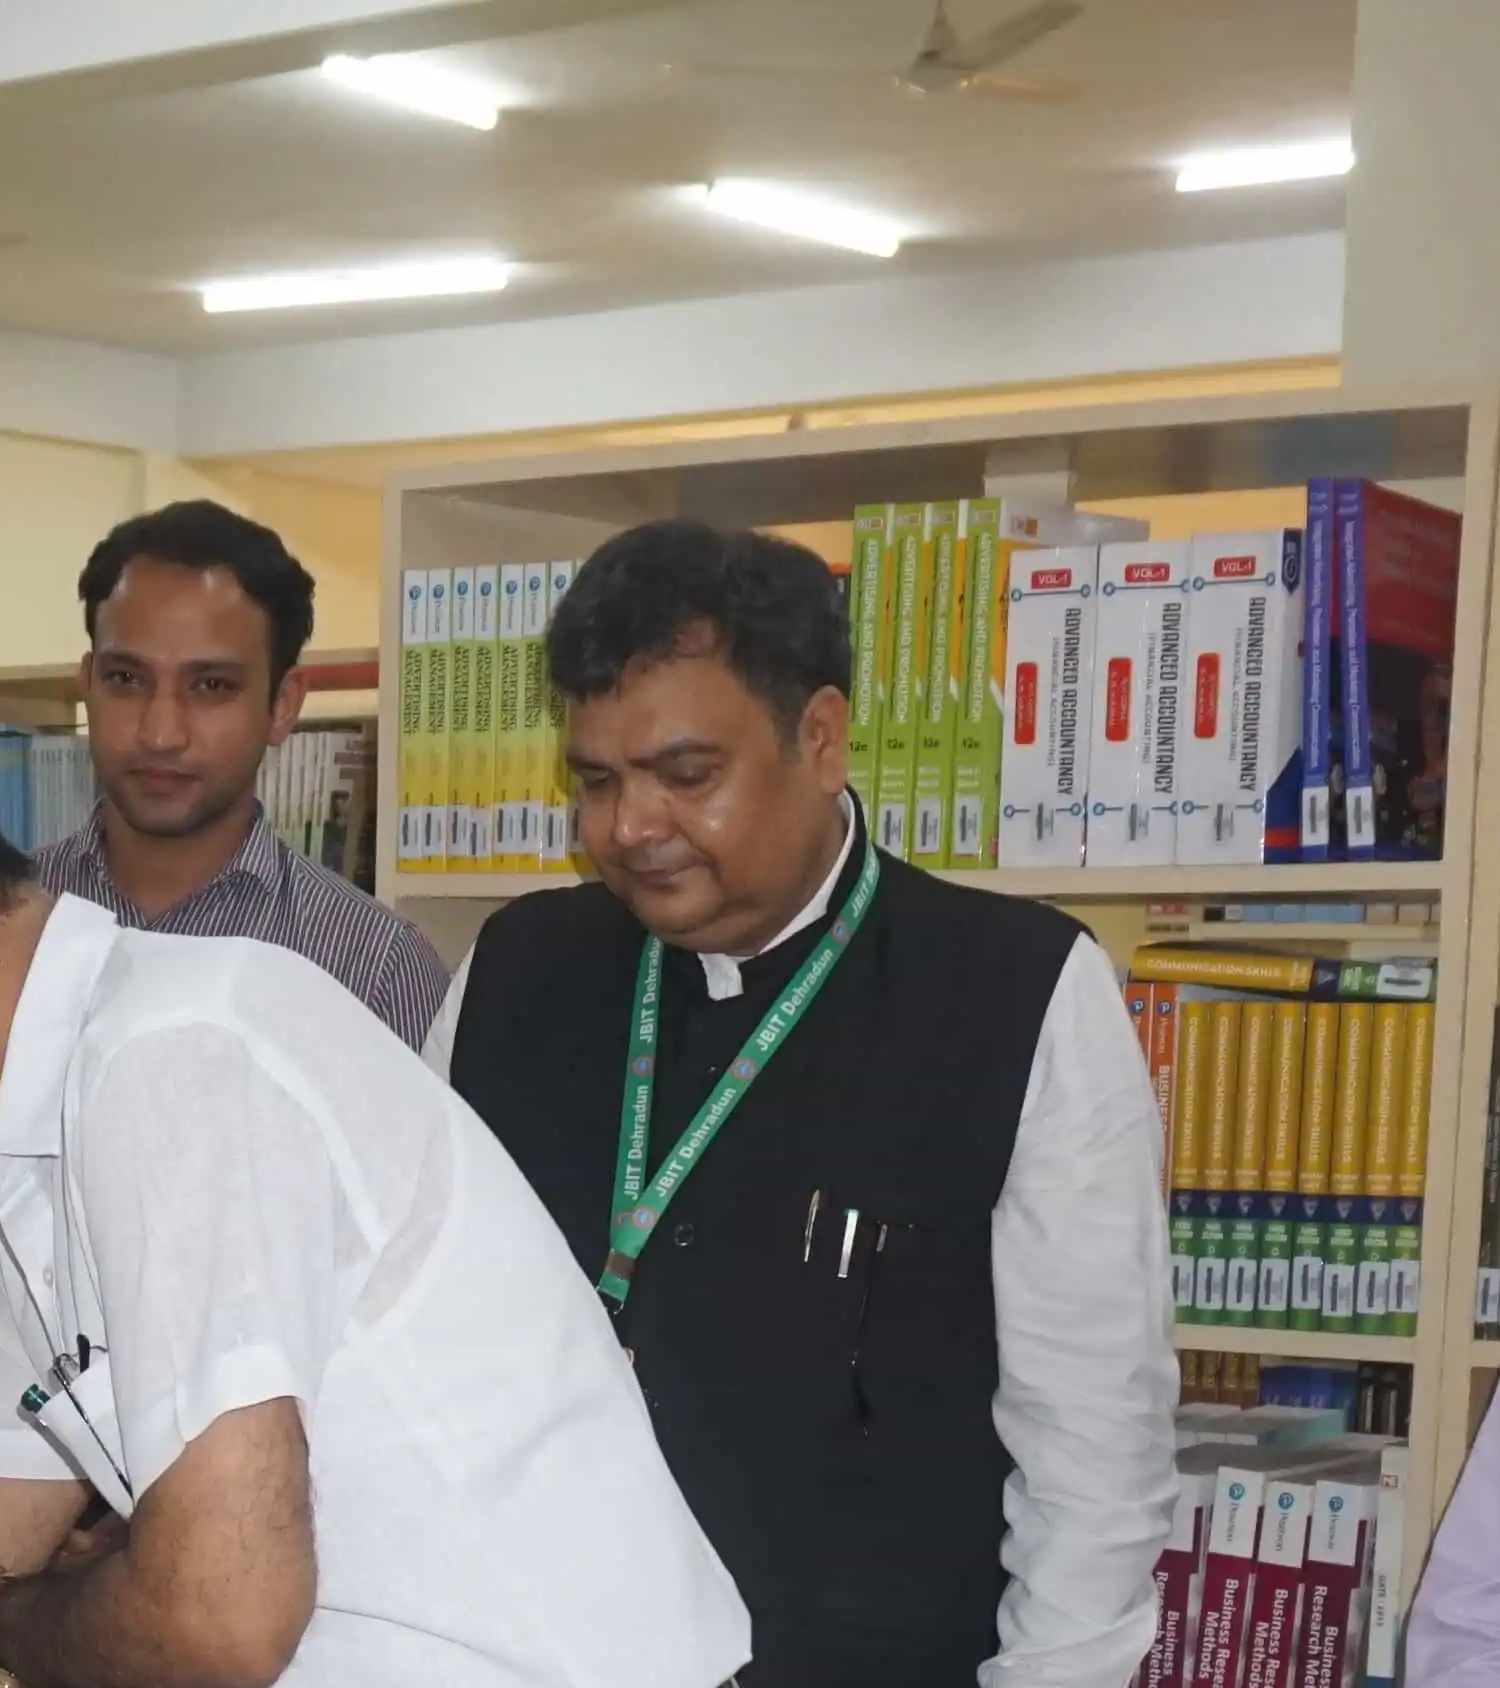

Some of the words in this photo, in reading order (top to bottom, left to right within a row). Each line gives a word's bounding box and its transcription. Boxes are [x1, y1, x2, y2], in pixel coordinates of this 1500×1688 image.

[1062, 607, 1081, 685] ADVANCED
[1159, 602, 1181, 681] ADVANCED
[1245, 597, 1266, 676] ADVANCED
[1057, 689, 1077, 795] ACCOUNTANCY
[1155, 685, 1178, 794] ACCOUNTANCY
[1240, 680, 1261, 791] ACCOUNTANCY
[639, 1003, 654, 1044] JBIT
[755, 1014, 784, 1053] JBIT
[781, 948, 834, 1016] Dehradun
[628, 1085, 649, 1162] Dehradun
[656, 1161, 683, 1199] JBIT
[681, 1087, 736, 1160] Dehradun
[624, 1165, 641, 1200] JBIT
[1163, 1611, 1180, 1676] Business
[1199, 1611, 1220, 1680] Methods
[1218, 1579, 1239, 1646] Business
[1268, 1588, 1288, 1655] Business
[1308, 1585, 1328, 1658] Research
